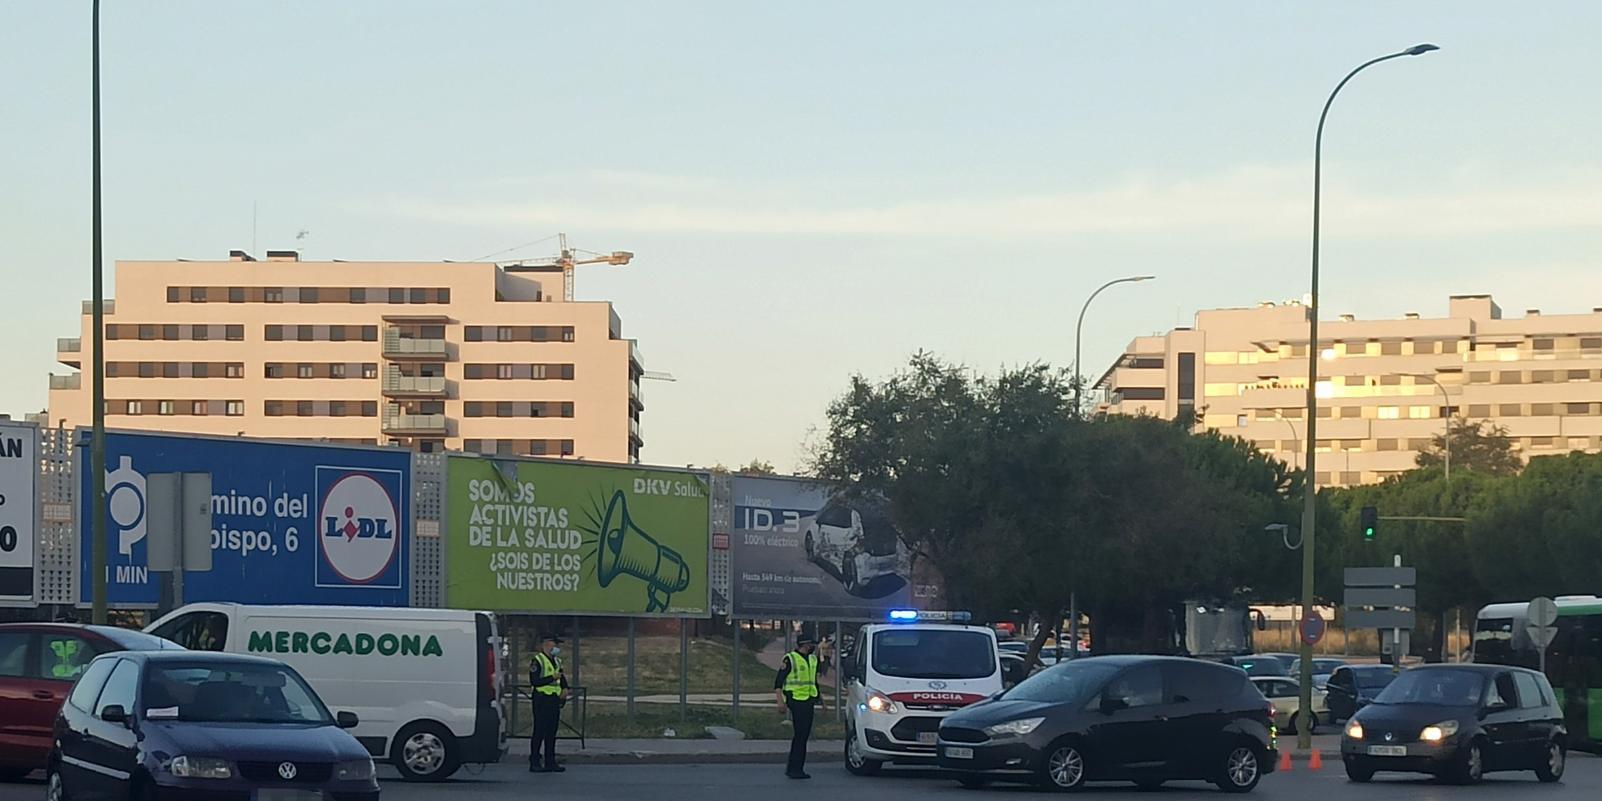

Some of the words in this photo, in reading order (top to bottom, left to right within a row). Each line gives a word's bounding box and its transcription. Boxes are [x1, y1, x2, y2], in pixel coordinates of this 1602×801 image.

[633, 478, 672, 496] DKV
[274, 492, 308, 518] del
[469, 503, 569, 529] ACTIVISTAS
[325, 507, 393, 543] LIDL
[744, 508, 800, 533] ID.3
[285, 527, 299, 552] 6
[468, 525, 493, 547] DE
[496, 526, 521, 547] LA
[525, 528, 582, 550] SALUD
[490, 551, 529, 572] ¿SOIS
[532, 552, 552, 571] DE
[554, 553, 582, 572] LOS
[116, 565, 148, 585] MIN
[496, 572, 580, 592] NUESTROS?
[248, 630, 443, 657] MERCADONA
